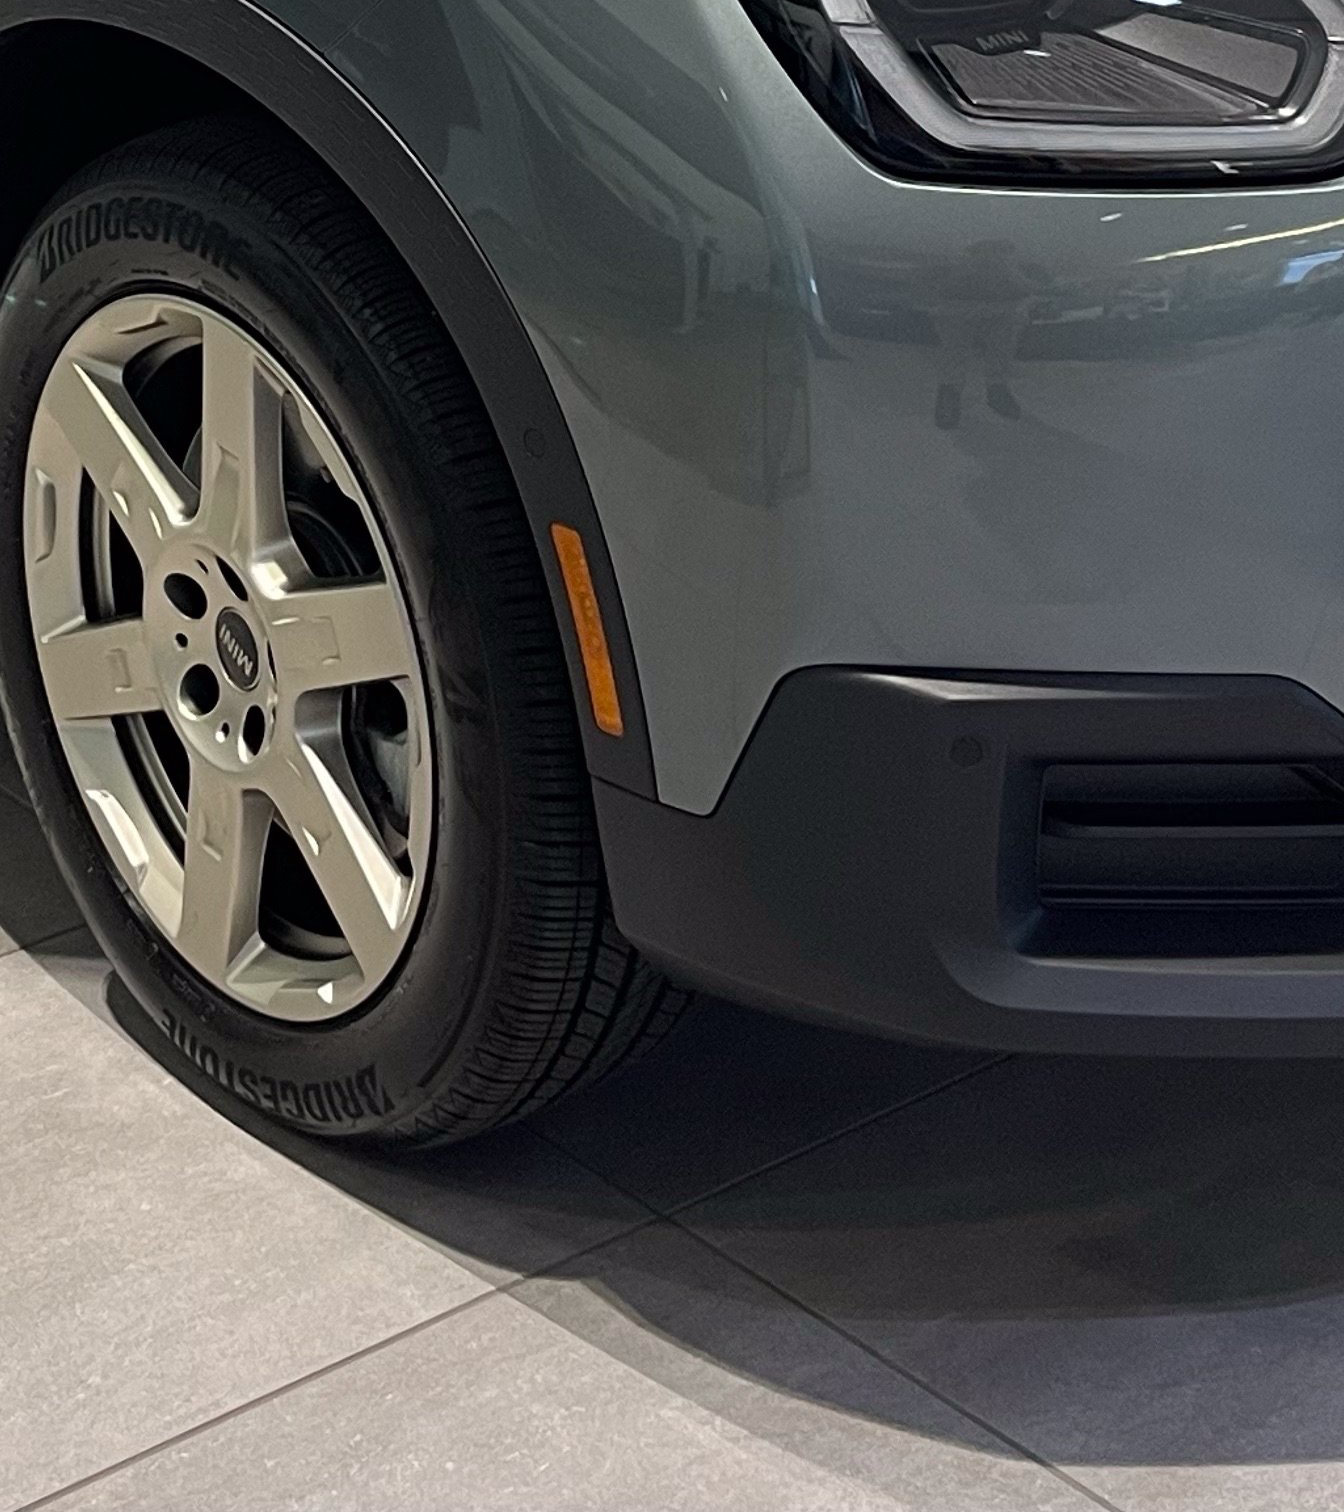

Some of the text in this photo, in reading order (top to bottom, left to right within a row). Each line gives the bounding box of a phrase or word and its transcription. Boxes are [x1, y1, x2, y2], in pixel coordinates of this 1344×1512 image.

[976, 31, 1028, 51] MINI
[35, 196, 253, 282] BRIDGESTONE
[218, 624, 253, 677] MINI
[161, 1008, 395, 1122] BRIDGESTONE
